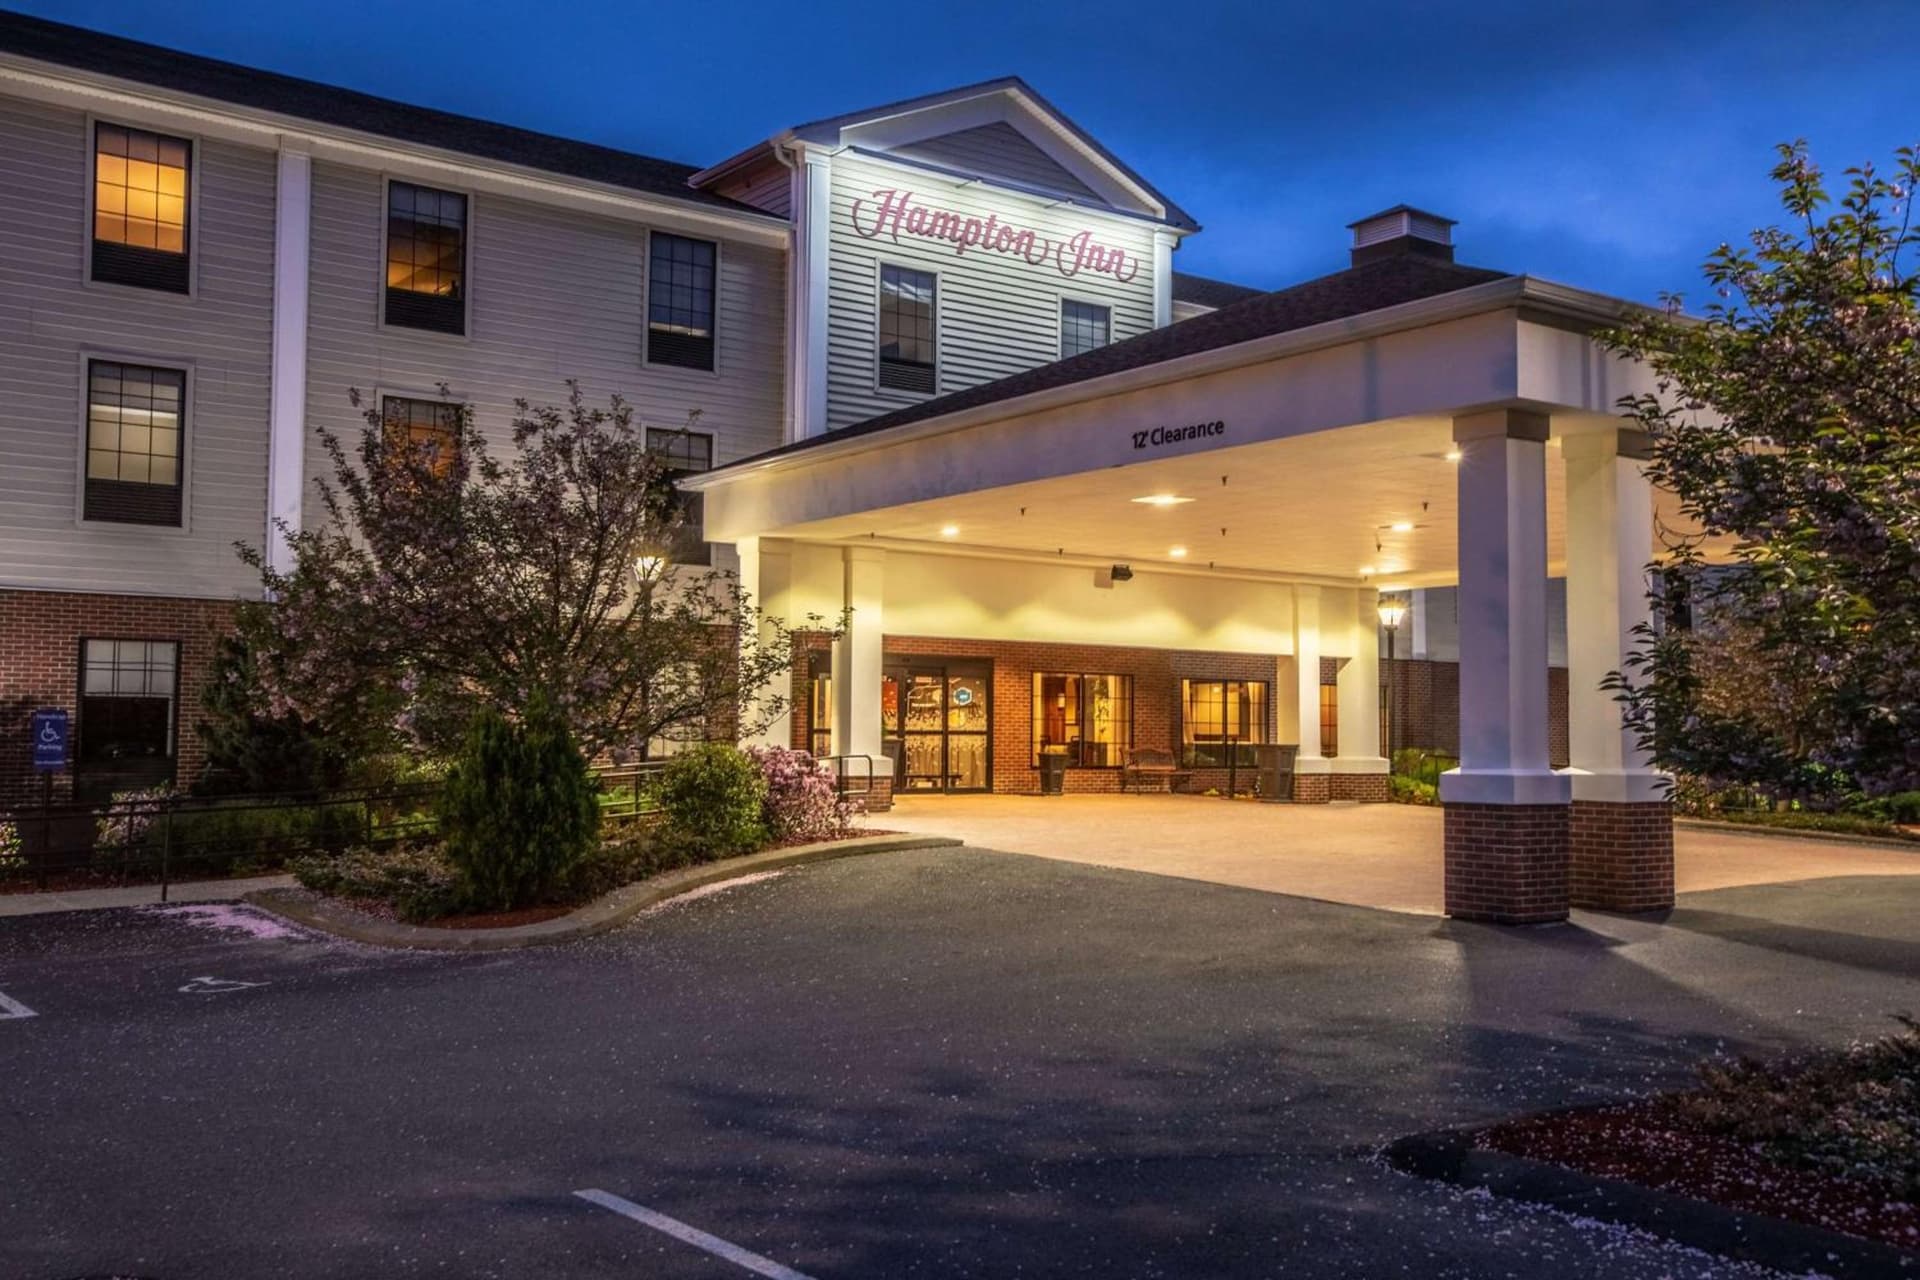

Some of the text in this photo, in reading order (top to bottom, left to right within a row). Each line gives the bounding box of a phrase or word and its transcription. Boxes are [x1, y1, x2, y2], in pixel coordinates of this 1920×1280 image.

[852, 189, 1138, 281] Hampton Inn
[1150, 420, 1225, 446] Clearance
